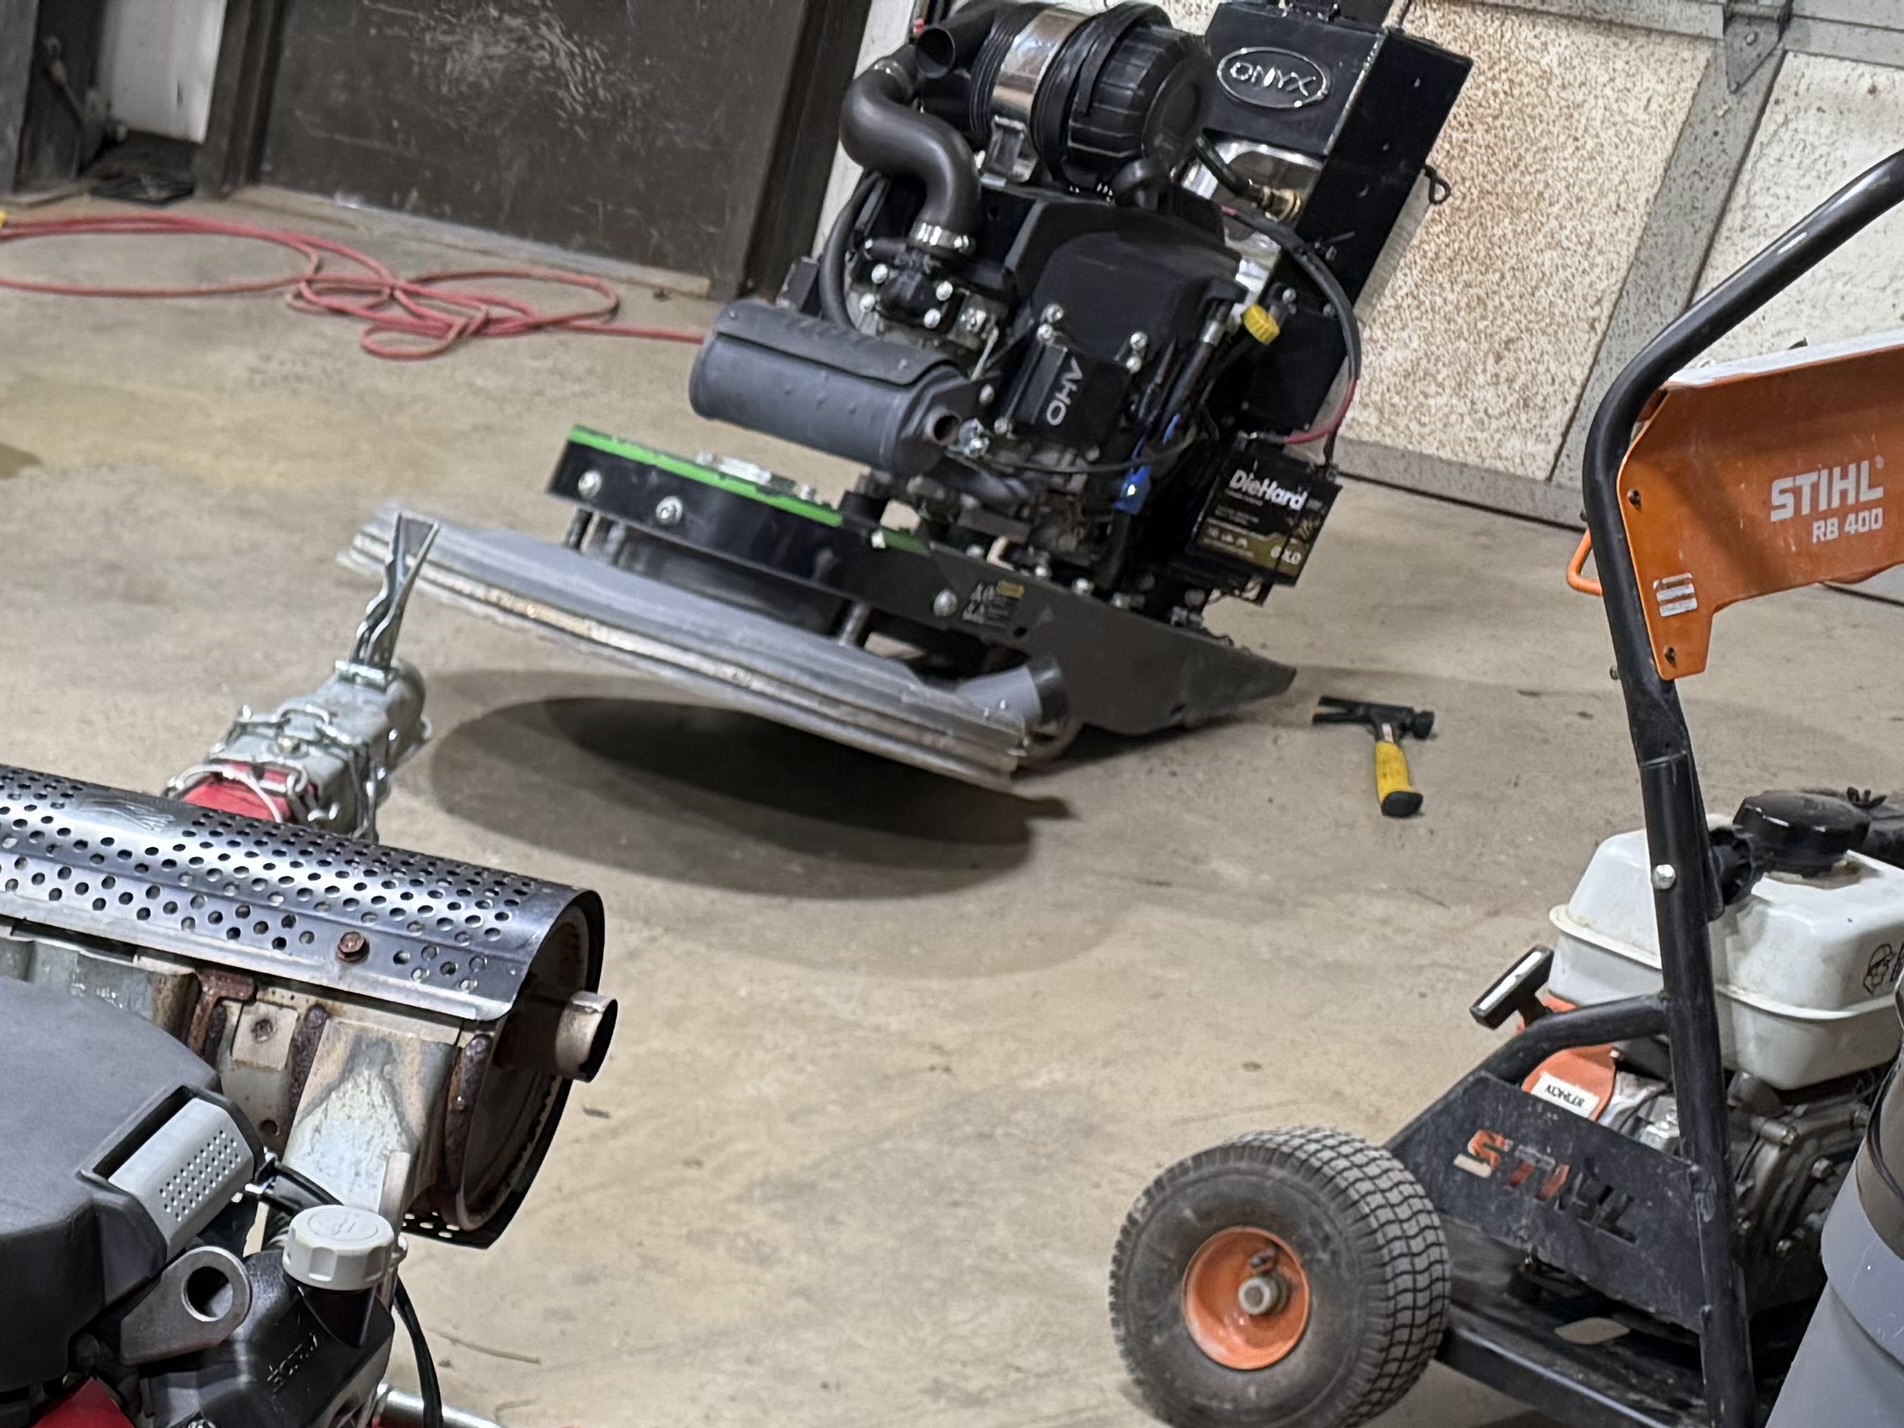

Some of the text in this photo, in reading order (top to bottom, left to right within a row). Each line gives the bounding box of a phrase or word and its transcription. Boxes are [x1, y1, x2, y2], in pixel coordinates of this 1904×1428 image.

[1230, 62, 1316, 96] ONYX
[1046, 356, 1083, 426] OHV
[1229, 469, 1308, 511] DieHard
[1770, 460, 1884, 522] STIHL
[1812, 507, 1883, 543] RB 400
[1453, 1129, 1638, 1247] STIHL
